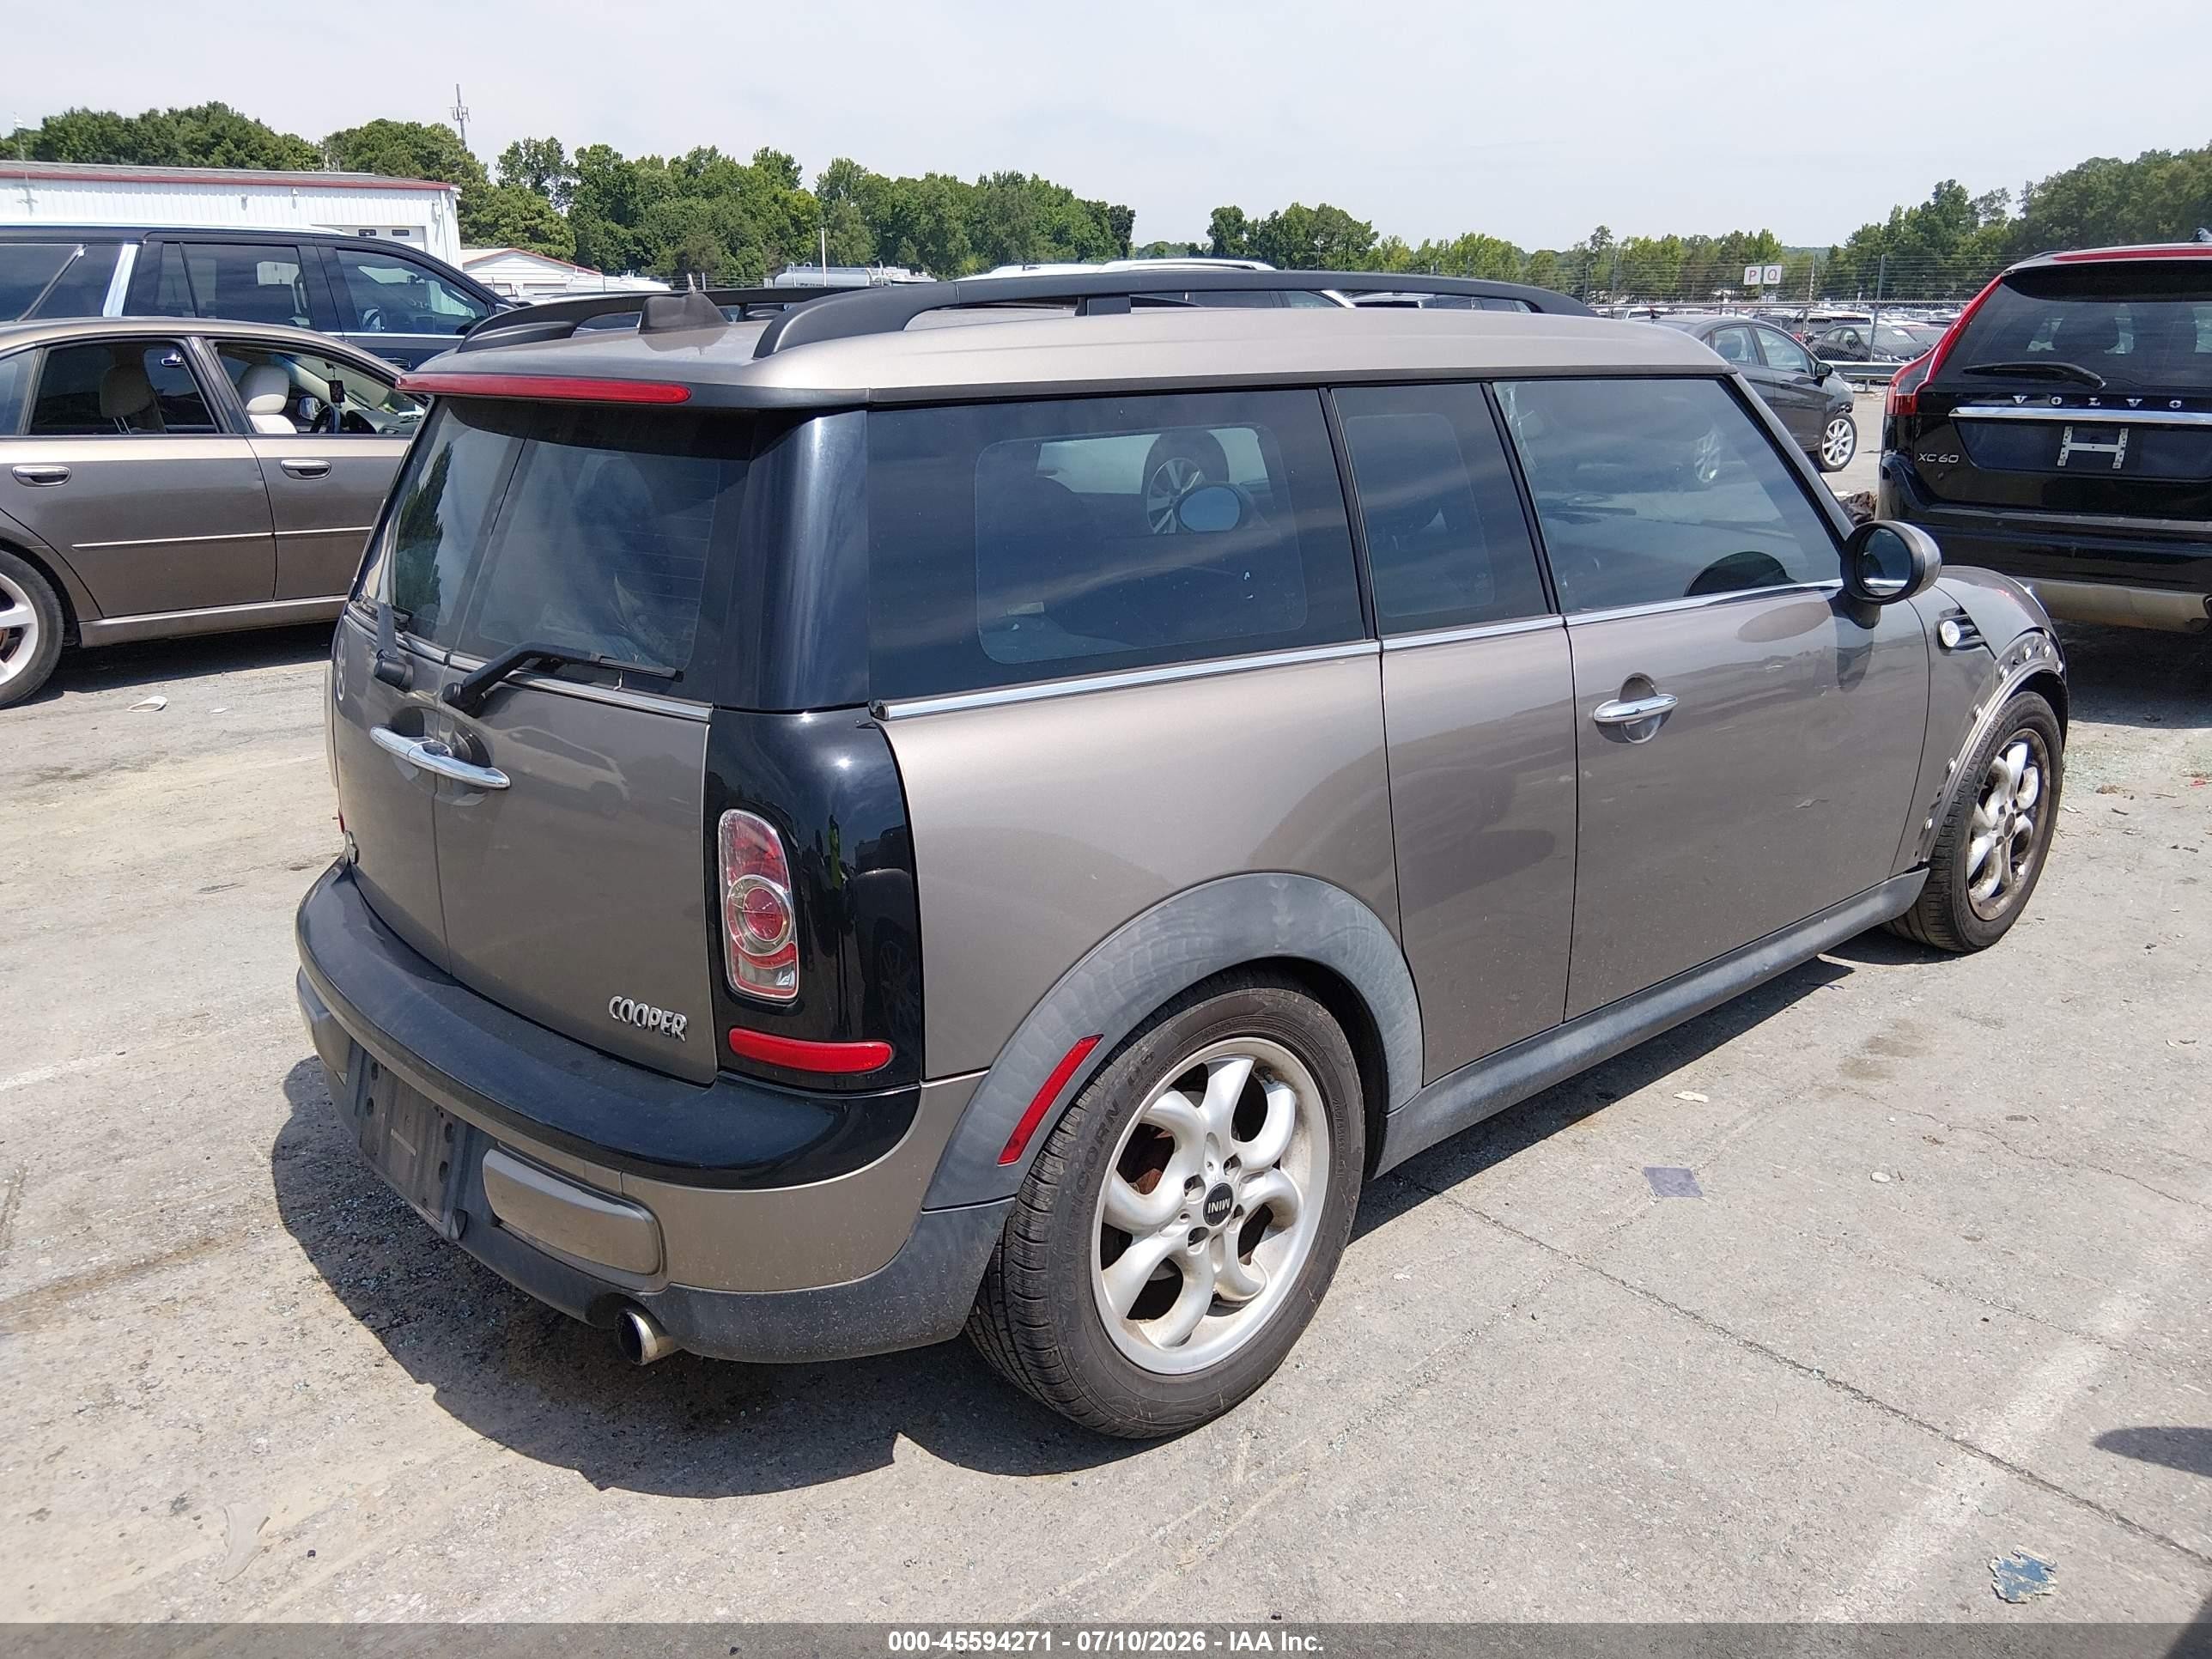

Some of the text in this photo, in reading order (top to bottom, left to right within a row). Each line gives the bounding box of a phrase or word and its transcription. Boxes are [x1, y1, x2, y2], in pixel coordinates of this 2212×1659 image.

[1748, 270, 1757, 282] P
[1767, 269, 1778, 281] Q
[2013, 395, 2182, 409] VOLVO
[608, 995, 687, 1042] COOPER
[1207, 1197, 1231, 1214] MINI
